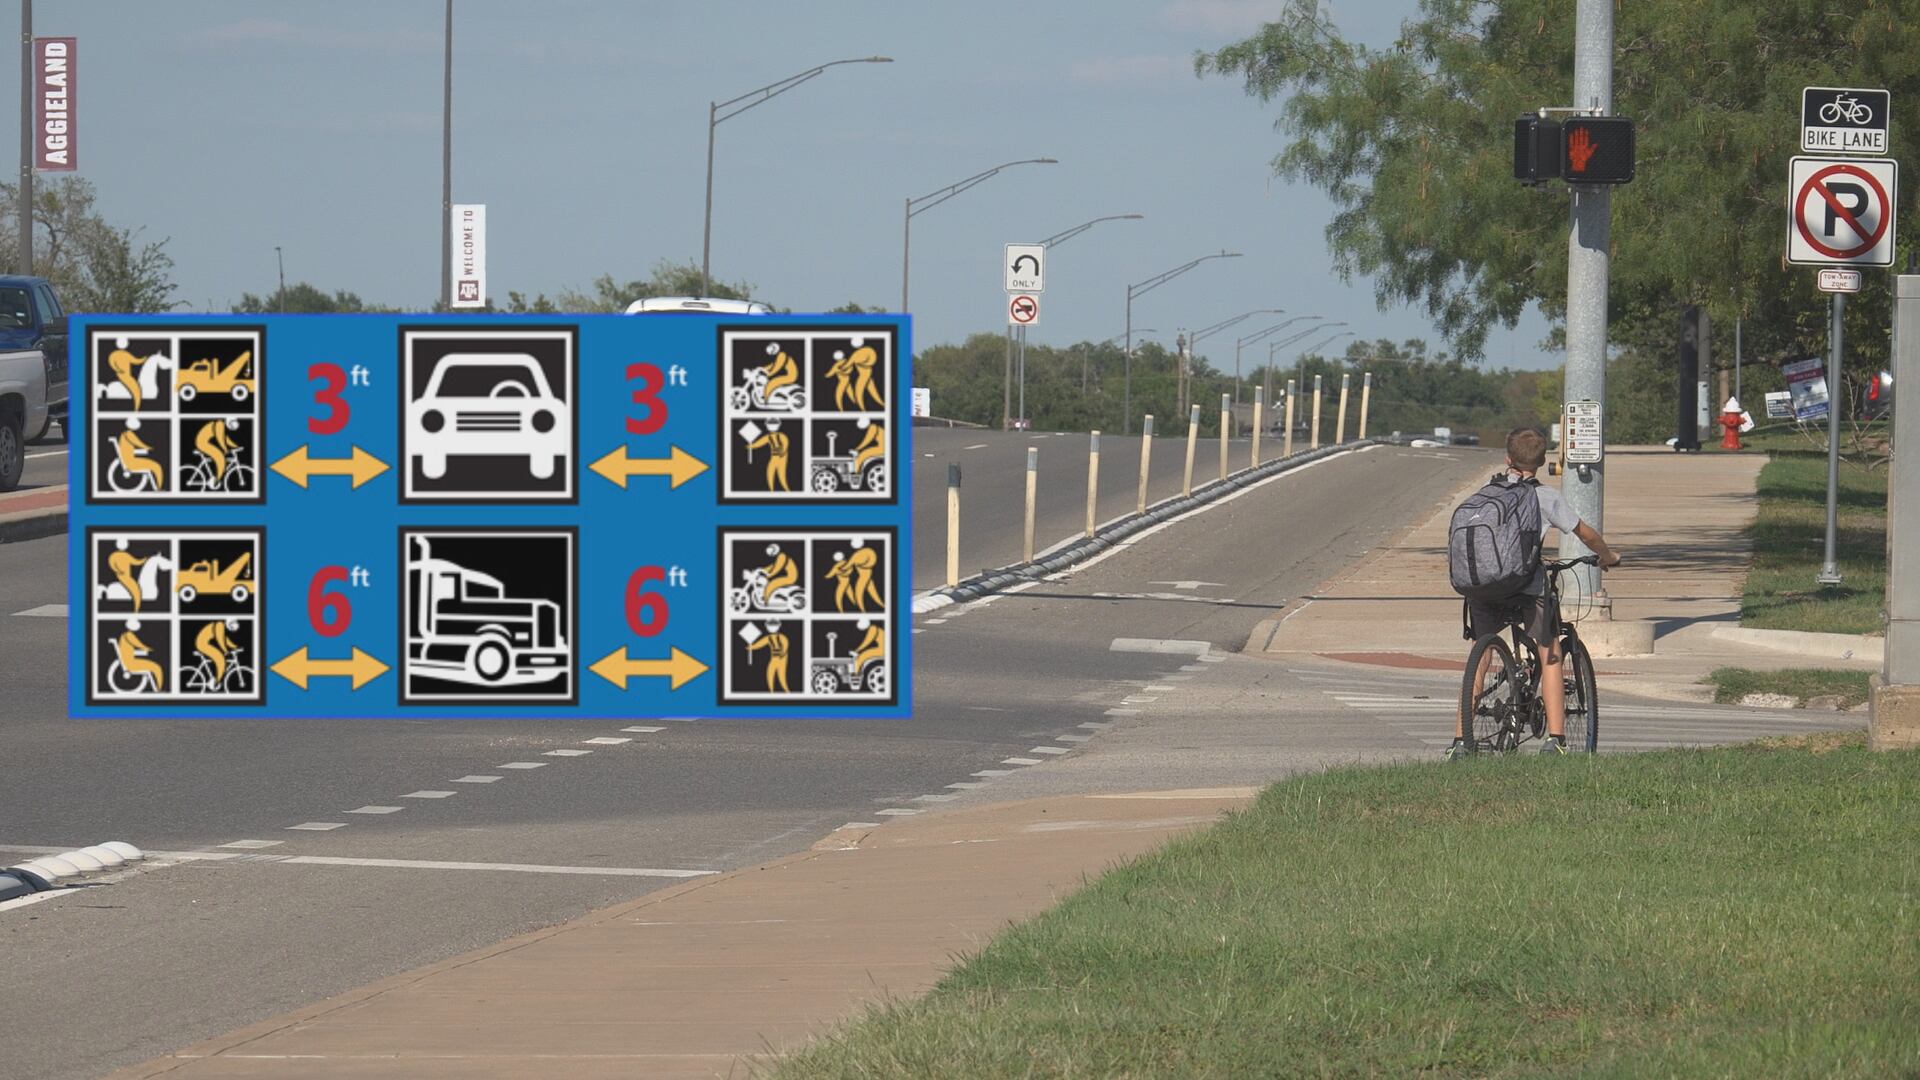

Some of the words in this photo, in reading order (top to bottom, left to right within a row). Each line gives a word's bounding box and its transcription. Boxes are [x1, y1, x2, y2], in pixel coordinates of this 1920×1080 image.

[45, 42, 67, 164] AGGIELAND
[1807, 130, 1836, 146] BIKE
[1843, 131, 1883, 148] LANE
[463, 210, 474, 222] TO
[1824, 181, 1869, 237] P
[463, 226, 474, 276] WELCOME
[1012, 279, 1036, 288] ONLY
